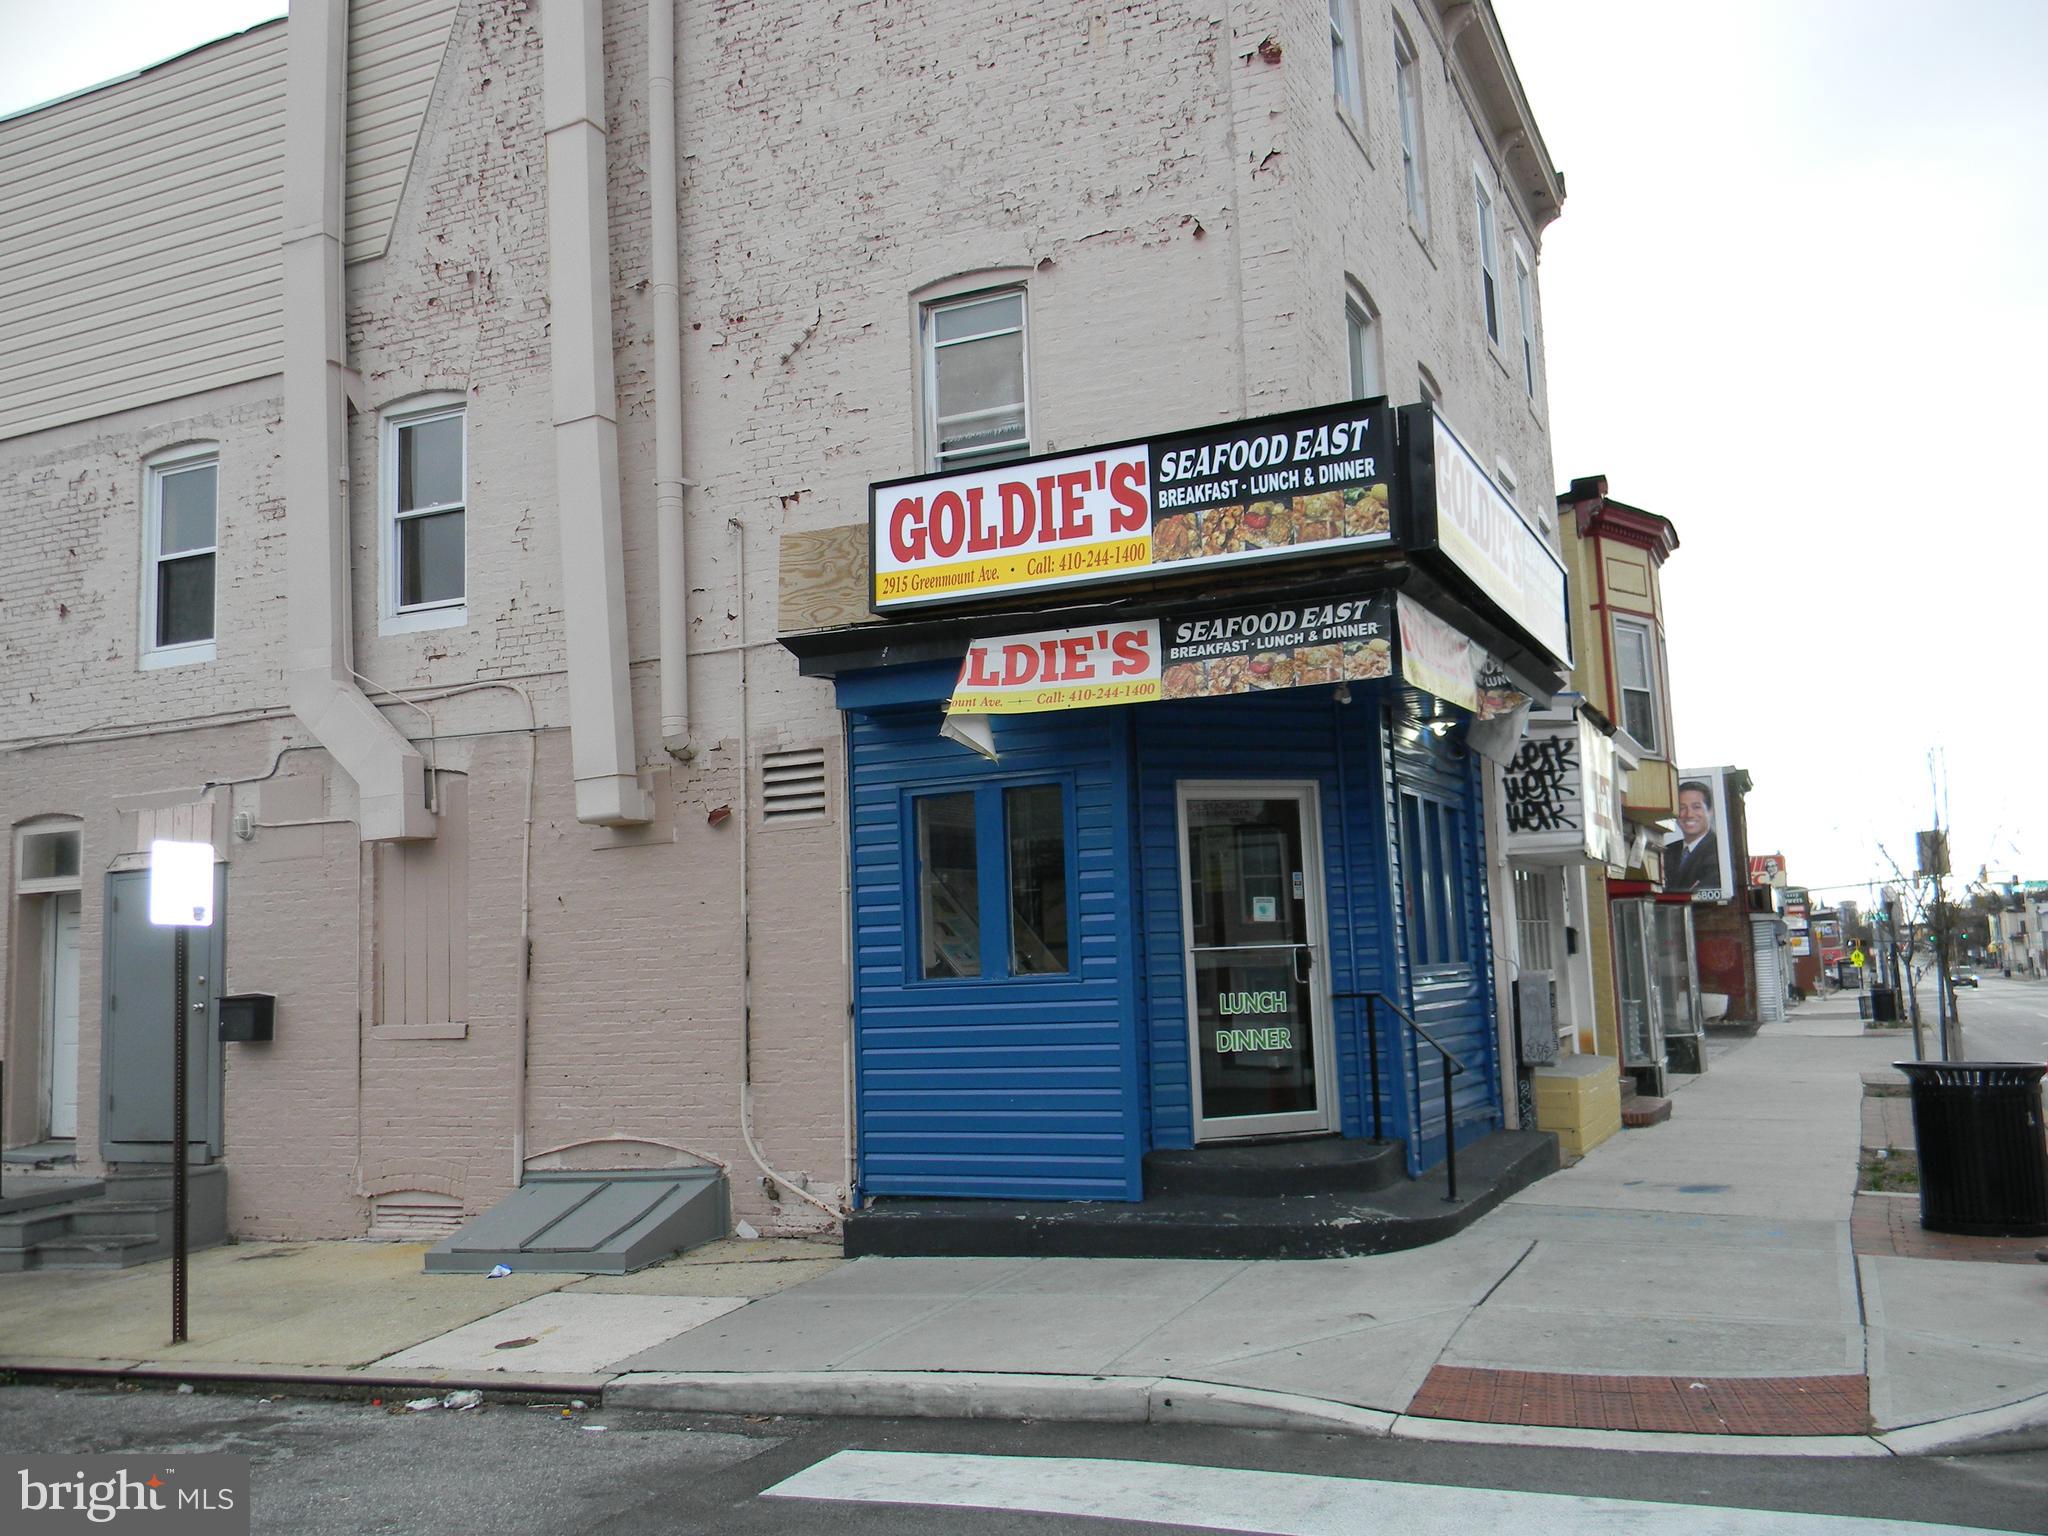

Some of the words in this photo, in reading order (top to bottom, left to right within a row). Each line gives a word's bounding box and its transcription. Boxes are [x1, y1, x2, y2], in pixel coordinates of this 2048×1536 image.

[1159, 434, 1289, 483] SEAFOOD
[1292, 418, 1369, 462] EAST
[1158, 479, 1239, 509] BREAKFAST
[1250, 469, 1299, 495] LUNCH
[1303, 467, 1315, 487] &
[1319, 457, 1376, 485] DINNER
[889, 460, 1148, 563] GOLDIE'S
[1436, 433, 1522, 592] GOLDIE'S
[883, 576, 908, 594] 2915
[911, 571, 974, 592] Greenmount
[978, 565, 1000, 582] Ave.
[1027, 555, 1055, 576] Call:
[1059, 543, 1146, 572] 410-244-1400
[1170, 639, 1249, 660] BREAKFAST
[1257, 633, 1304, 650] LUNCH
[1308, 630, 1318, 642] &
[1322, 621, 1378, 640] DINNER
[1176, 609, 1296, 644] SEAFOOD
[1300, 599, 1372, 629] EAST
[980, 697, 1003, 707] Ave.
[1036, 691, 1065, 704] Call:
[1069, 683, 1155, 702] 410-244-1400
[1219, 991, 1287, 1015] LUNCH
[1216, 1027, 1292, 1053] DINNER
